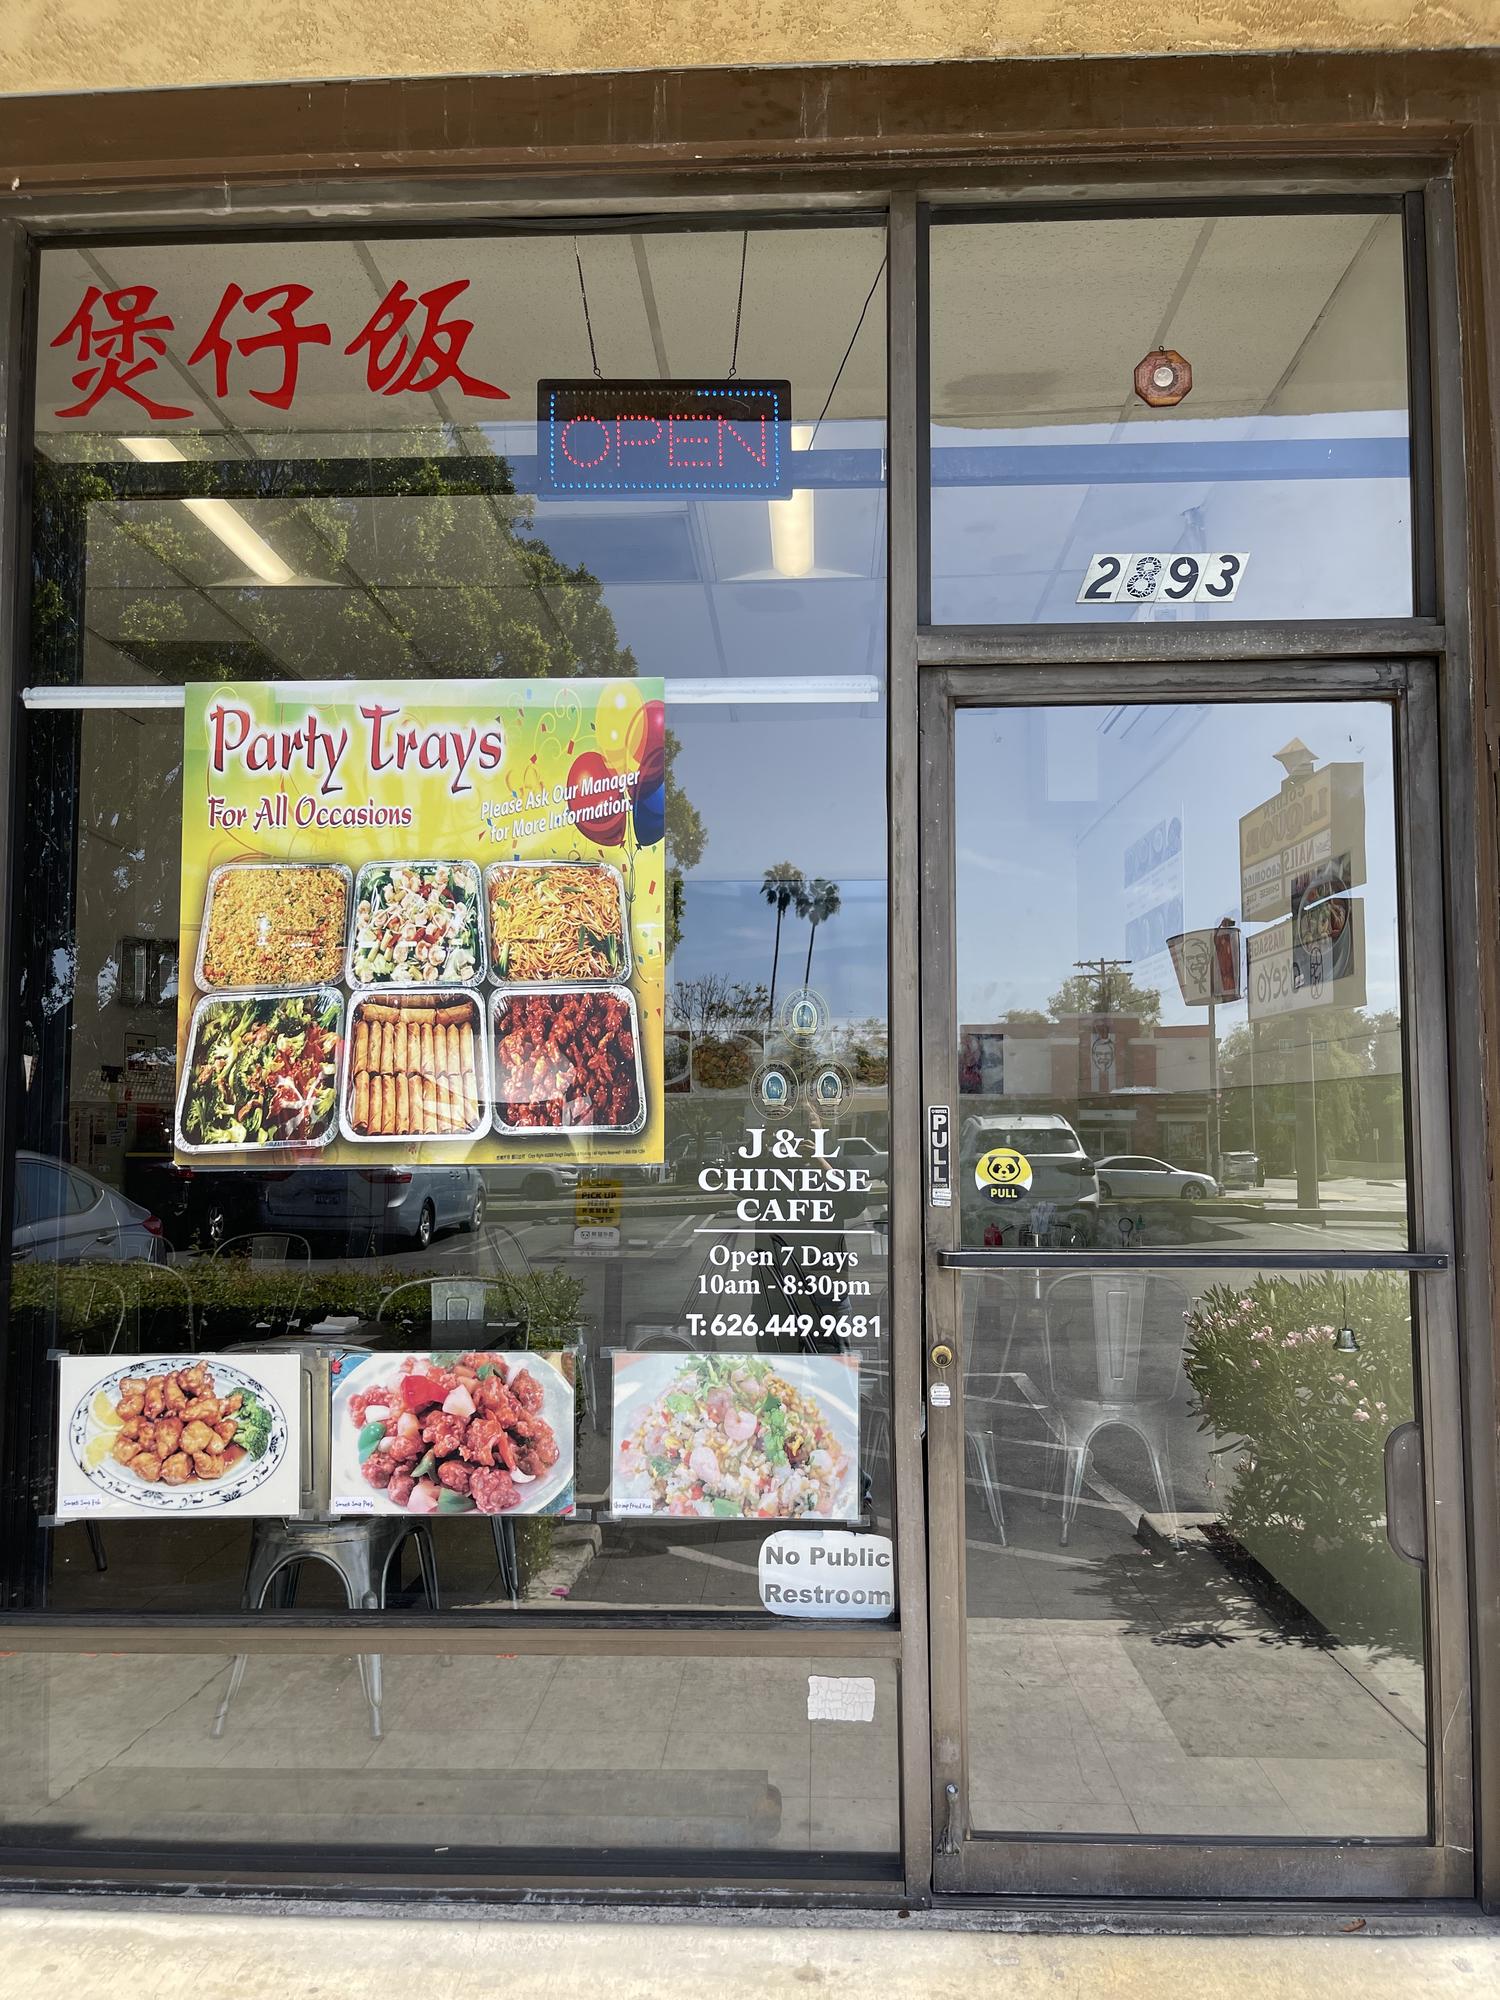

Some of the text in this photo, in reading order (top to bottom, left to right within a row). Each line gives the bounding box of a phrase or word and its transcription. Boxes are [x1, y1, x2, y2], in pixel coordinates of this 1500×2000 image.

[50, 278, 511, 421] 煲仔饭
[561, 413, 768, 469] OPEN
[1084, 554, 1240, 599] 2893
[210, 704, 502, 795] Party Trays
[481, 769, 641, 821] Please Ask Our Manager
[208, 795, 412, 831] For All Occasions
[489, 797, 633, 843] for More Information.
[738, 1128, 840, 1159] J & L
[932, 1114, 947, 1182] PULL
[698, 1168, 872, 1193] CHINESE
[991, 1188, 1018, 1199] PULL
[736, 1198, 836, 1223] CAFE
[709, 1245, 859, 1272] Open 7 Days
[698, 1274, 761, 1296] 10am
[783, 1274, 872, 1301] 8:30pm
[766, 1546, 891, 1567] No Public
[765, 1584, 891, 1605] Restroom
